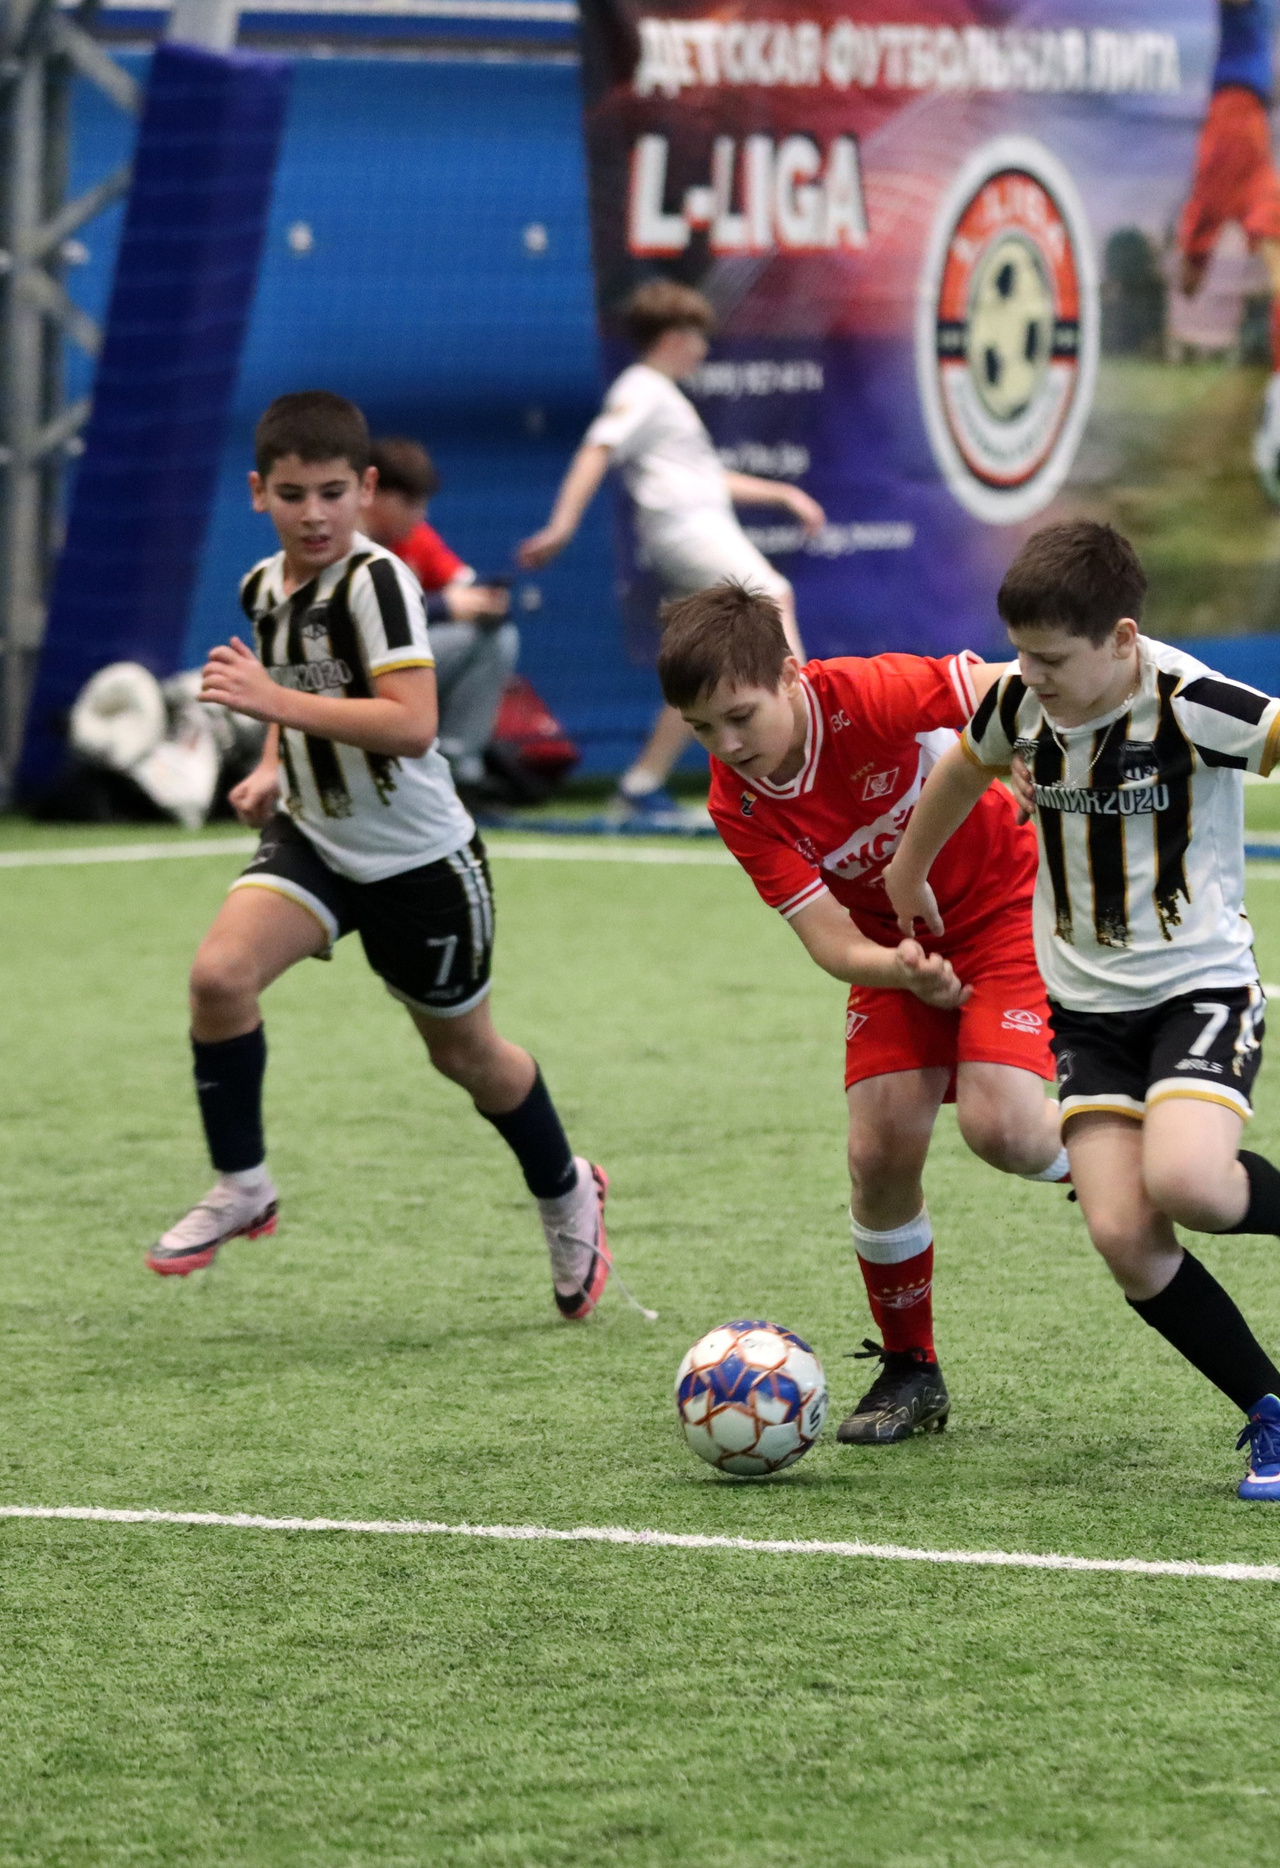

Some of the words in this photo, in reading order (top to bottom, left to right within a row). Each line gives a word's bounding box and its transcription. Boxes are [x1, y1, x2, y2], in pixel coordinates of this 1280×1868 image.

[633, 17, 821, 98] ДЕТСКАЯ
[425, 934, 458, 987] 7
[1188, 1002, 1231, 1057] 7
